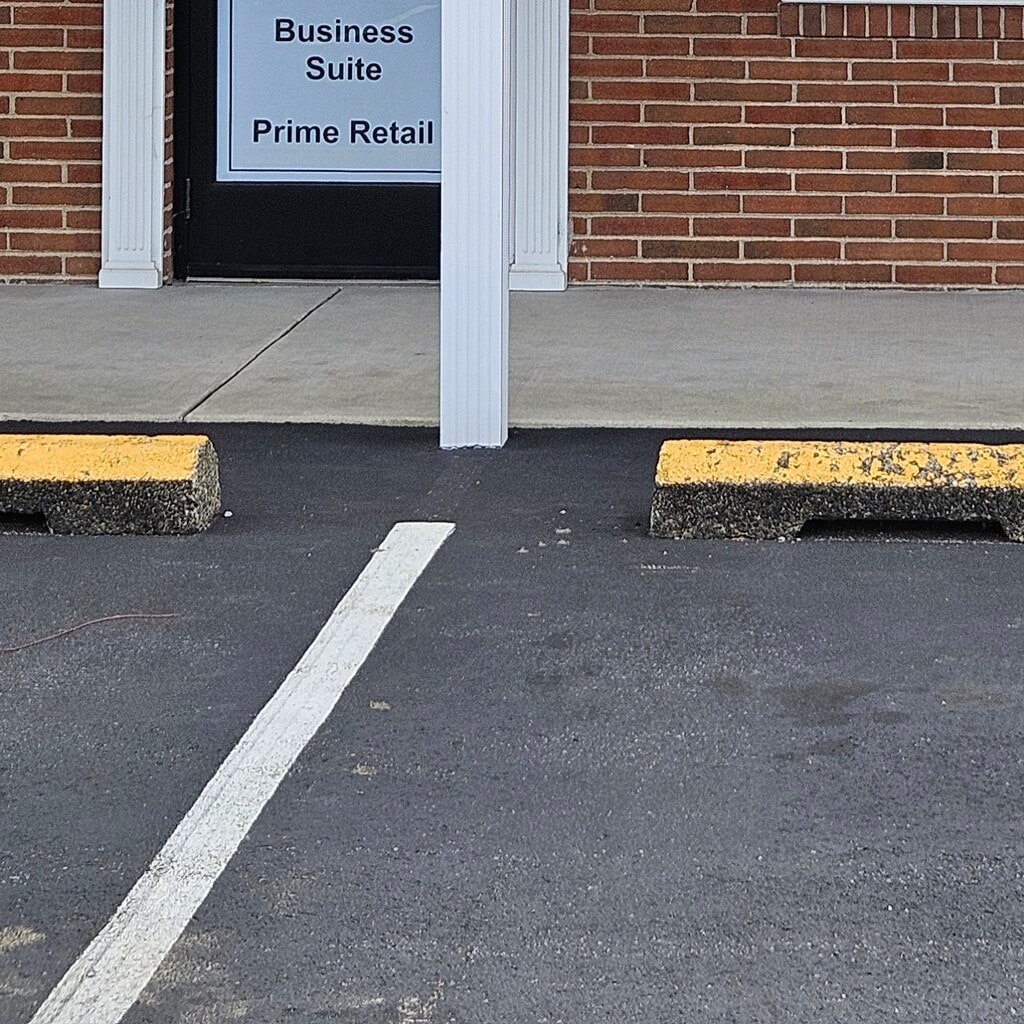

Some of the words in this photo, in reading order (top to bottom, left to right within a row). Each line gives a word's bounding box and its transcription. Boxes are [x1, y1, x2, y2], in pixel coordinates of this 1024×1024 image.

[274, 18, 414, 44] Business
[305, 55, 383, 81] Suite
[252, 119, 340, 144] Prime
[349, 119, 434, 144] Retail
